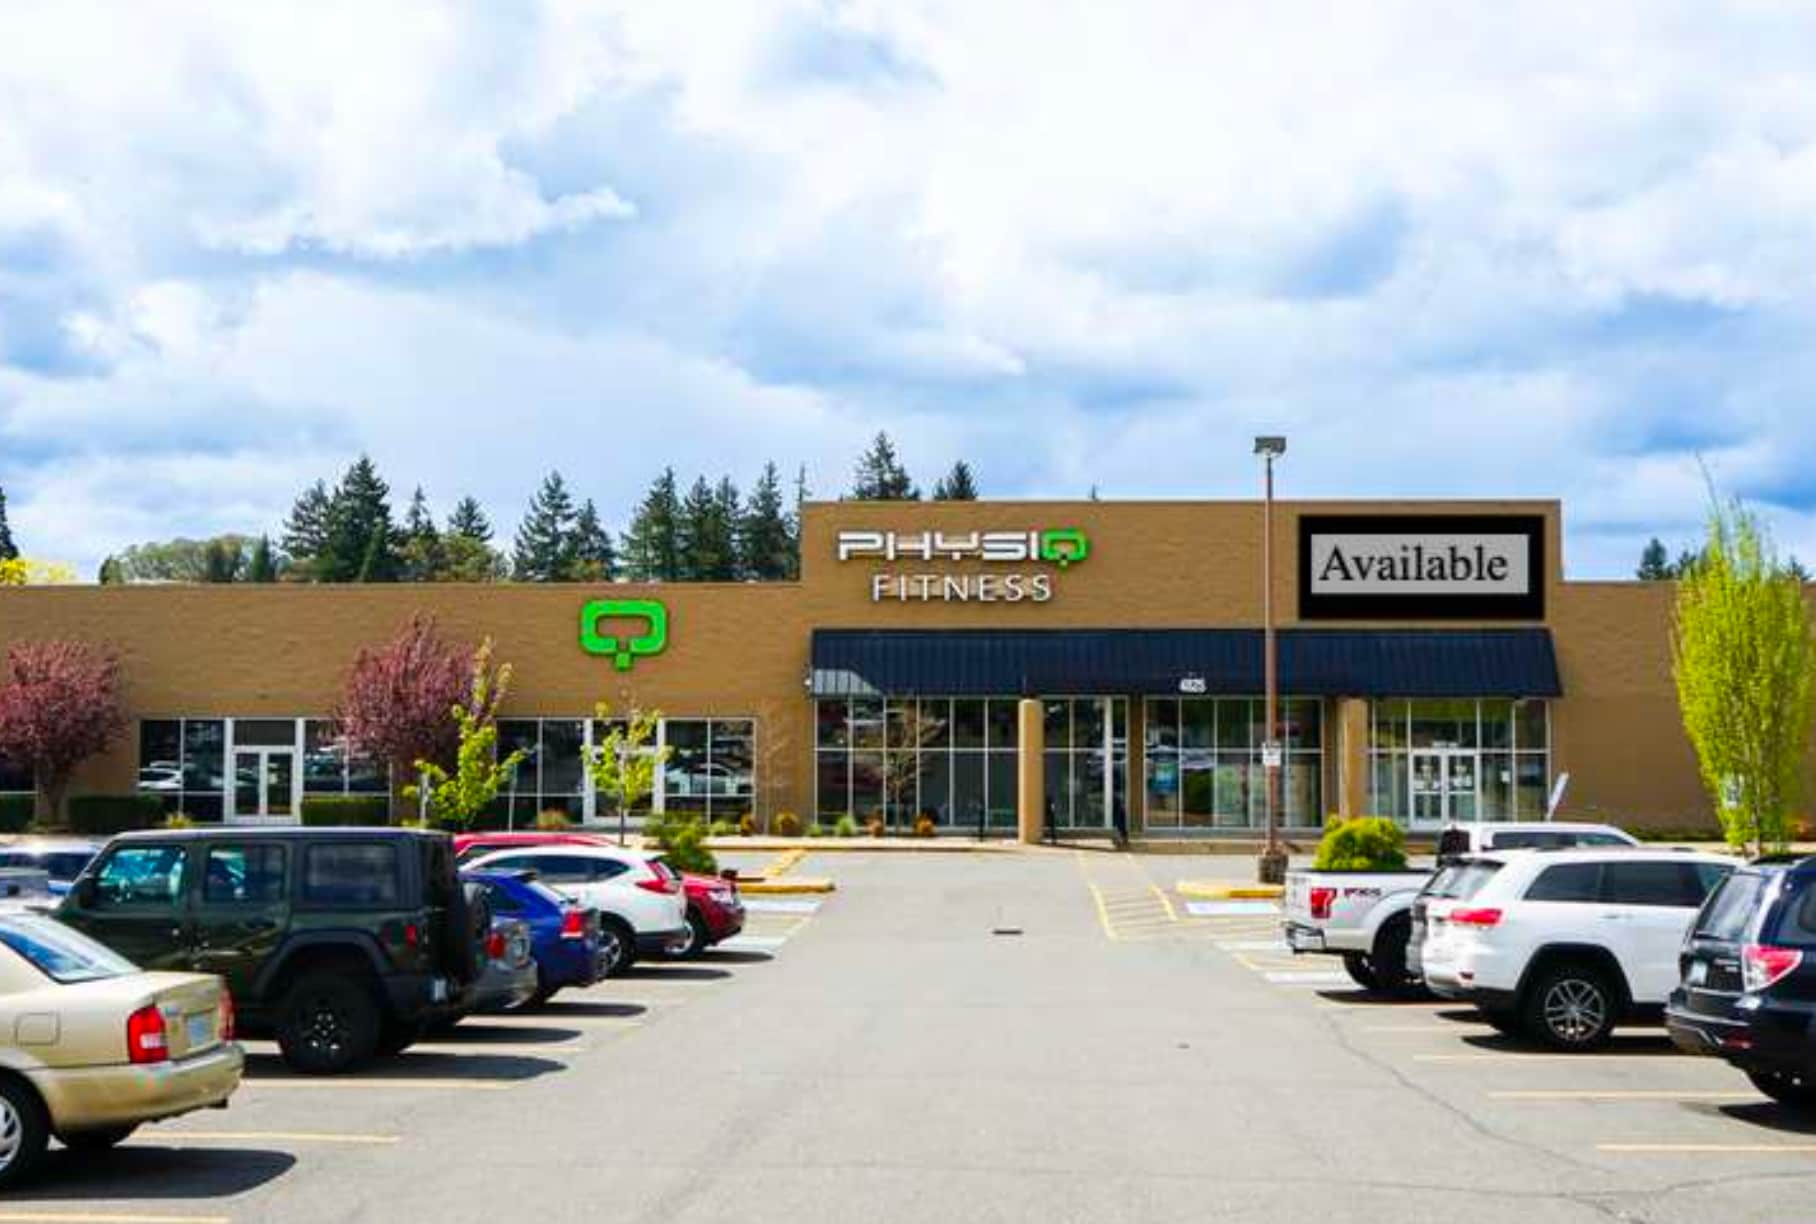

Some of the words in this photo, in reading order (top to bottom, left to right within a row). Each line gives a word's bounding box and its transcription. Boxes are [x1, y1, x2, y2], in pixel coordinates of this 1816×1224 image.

[838, 529, 1090, 568] PHYSIQ
[1318, 543, 1509, 582] Available
[872, 573, 1052, 601] FITNESS
